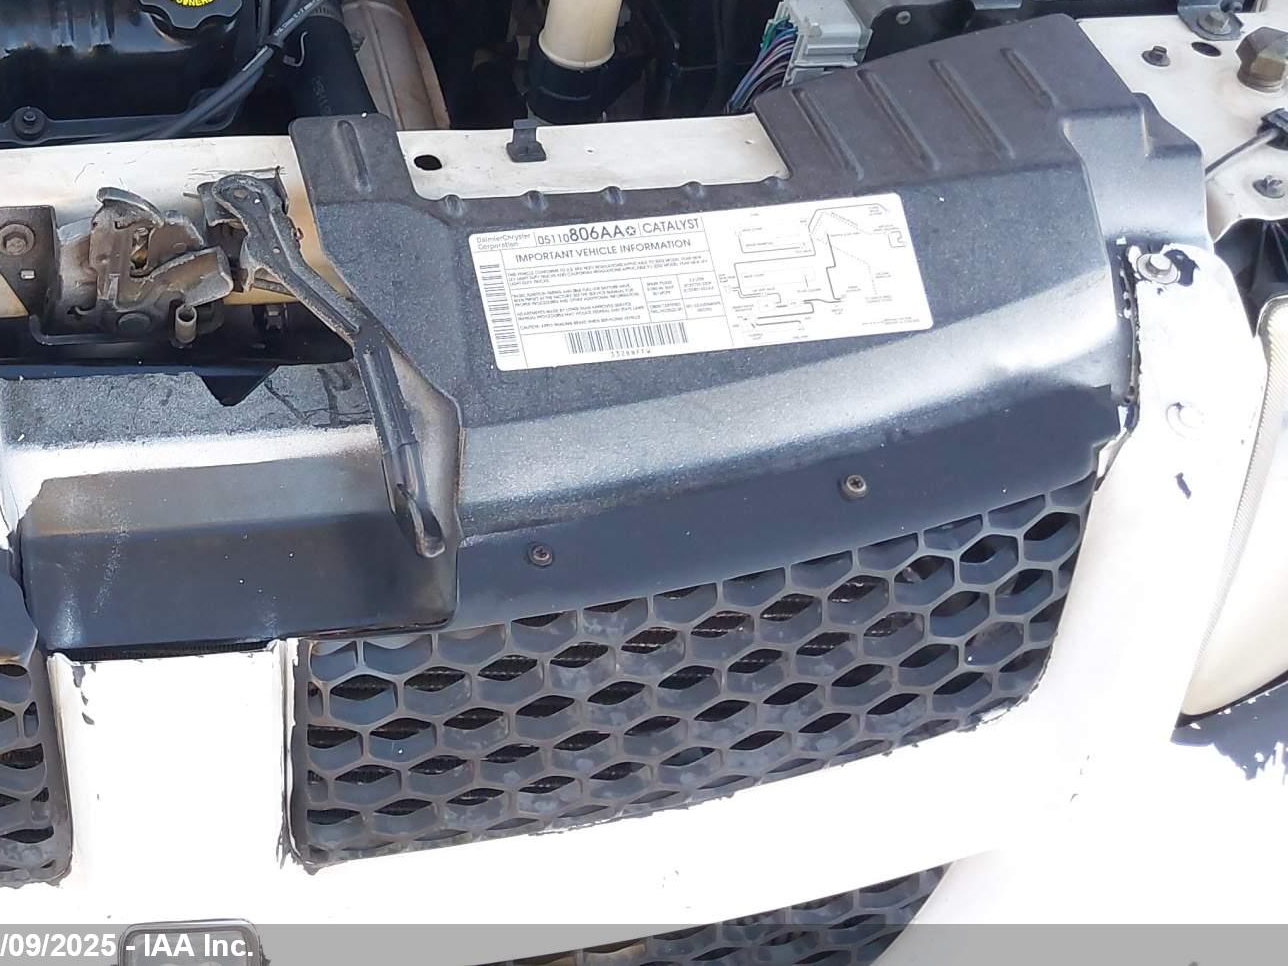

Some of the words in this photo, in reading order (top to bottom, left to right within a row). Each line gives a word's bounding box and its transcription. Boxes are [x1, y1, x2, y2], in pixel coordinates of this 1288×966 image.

[642, 218, 701, 234] CATALYST
[476, 233, 531, 244] DaimlerChrysler
[478, 241, 519, 250] Corporation
[515, 250, 575, 264] IMPORTANT
[575, 245, 618, 258] VEHICLE
[620, 239, 691, 255] INFORMATION
